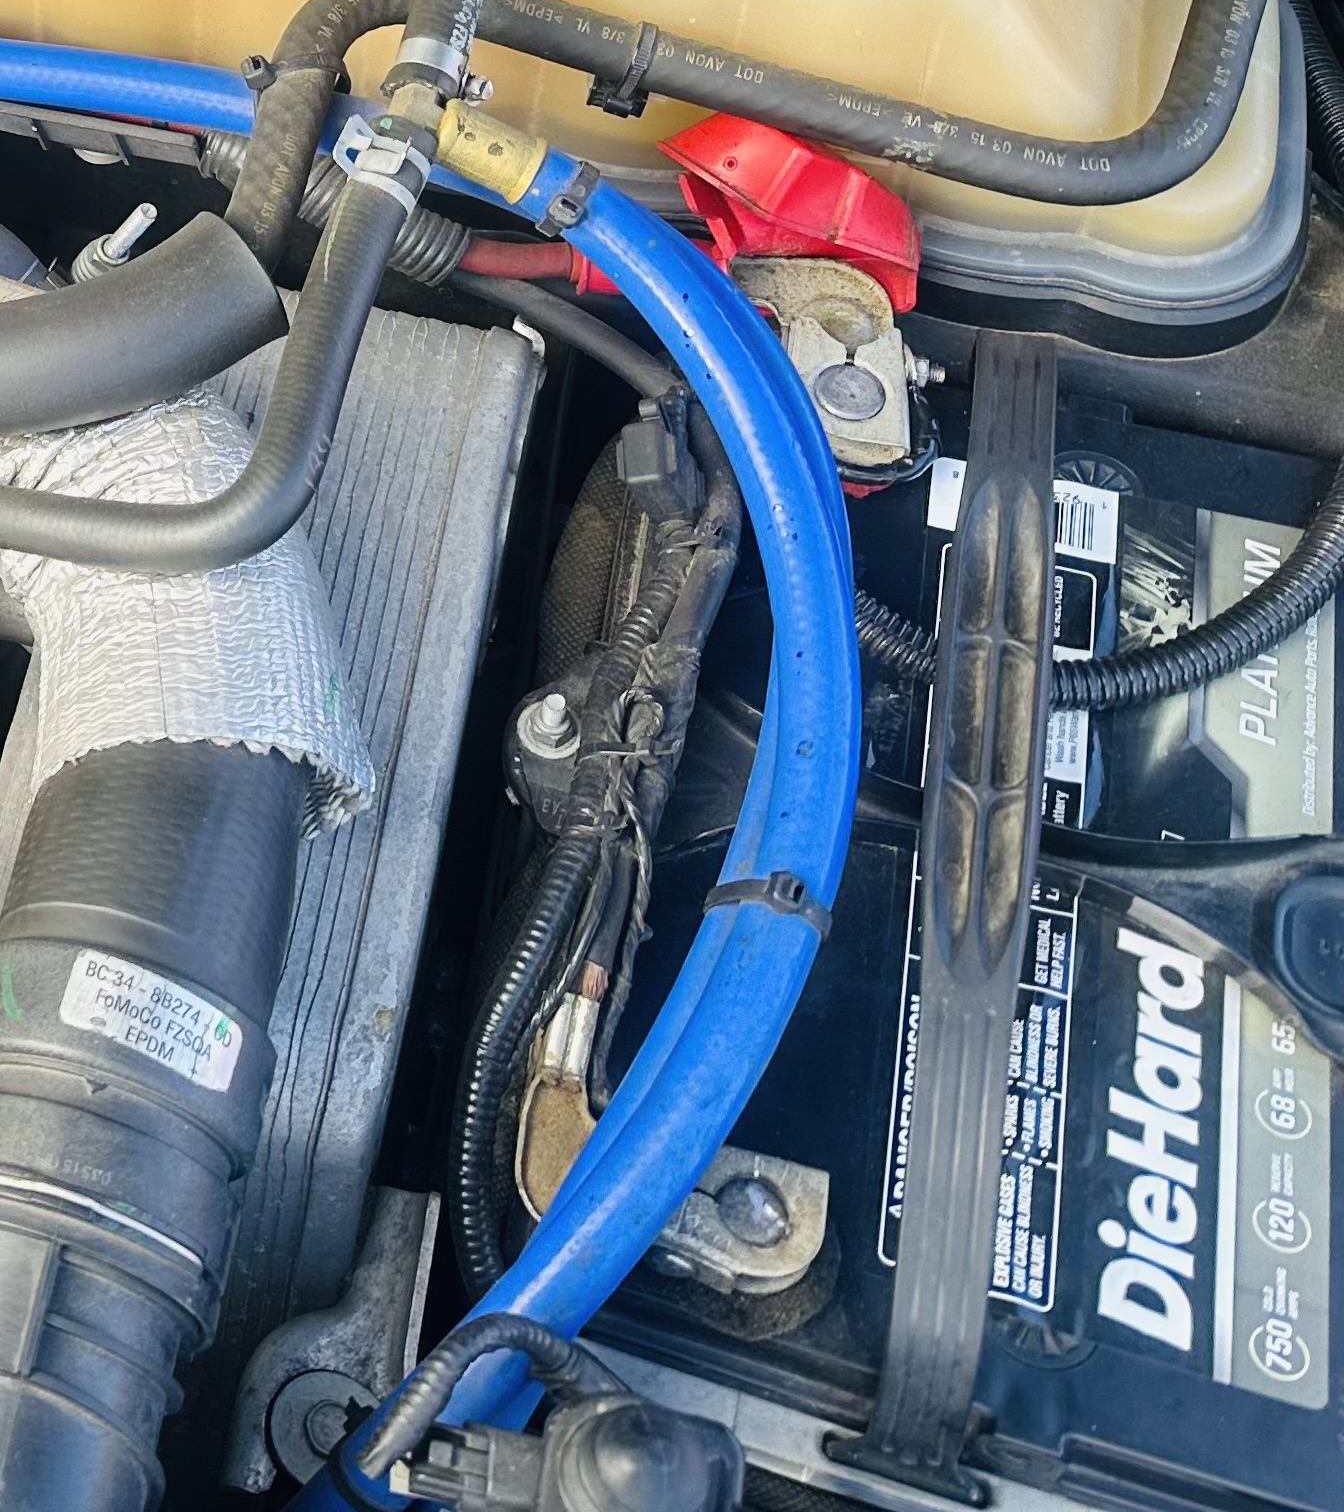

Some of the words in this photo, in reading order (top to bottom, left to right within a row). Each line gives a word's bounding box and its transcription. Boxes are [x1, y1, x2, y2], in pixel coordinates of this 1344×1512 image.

[327, 4, 348, 24] 3/8
[575, 17, 591, 35] VL
[317, 24, 335, 39] VL
[601, 26, 626, 45] 3/8
[685, 50, 725, 73] AVON
[734, 64, 764, 85] DOT
[1213, 64, 1232, 89] 3/8
[280, 134, 299, 159] DOT
[970, 131, 986, 148] 15
[992, 138, 1012, 155] 03
[1024, 146, 1066, 167] AVON
[1079, 157, 1111, 172] DOT
[269, 162, 290, 199] AVON
[261, 199, 277, 219] 03
[1304, 668, 1318, 692] Auto
[1302, 694, 1317, 737] Advance
[1302, 741, 1318, 758] by:
[1299, 758, 1317, 815] Distributed
[1035, 917, 1050, 962] MEDICAL
[1034, 964, 1048, 983] GET
[1050, 961, 1063, 988] HELP
[150, 986, 202, 1026] 8B274
[1029, 1004, 1041, 1021] OR
[95, 988, 163, 1029] FoMoCo
[165, 1021, 212, 1062] FZSQA
[125, 1026, 175, 1062] EPDM
[1025, 1023, 1041, 1082] BLINDNESS
[1042, 1047, 1058, 1087] SEVERE
[1003, 1094, 1019, 1138] SPARKS
[1021, 1098, 1036, 1142] FLAMES
[1038, 1097, 1054, 1148] SMOKING
[1271, 1092, 1295, 1131] 68
[1097, 927, 1205, 1351] DieHard
[998, 1173, 1015, 1216] GASES
[1016, 1165, 1033, 1227] BLINDNESS
[1268, 1198, 1295, 1242] 120
[993, 1218, 1013, 1287] EXPLOSIVE
[1014, 1230, 1029, 1270] CAUSE
[1012, 1272, 1026, 1291] CAN
[1028, 1283, 1042, 1298] OR
[1265, 1318, 1294, 1372] 750
